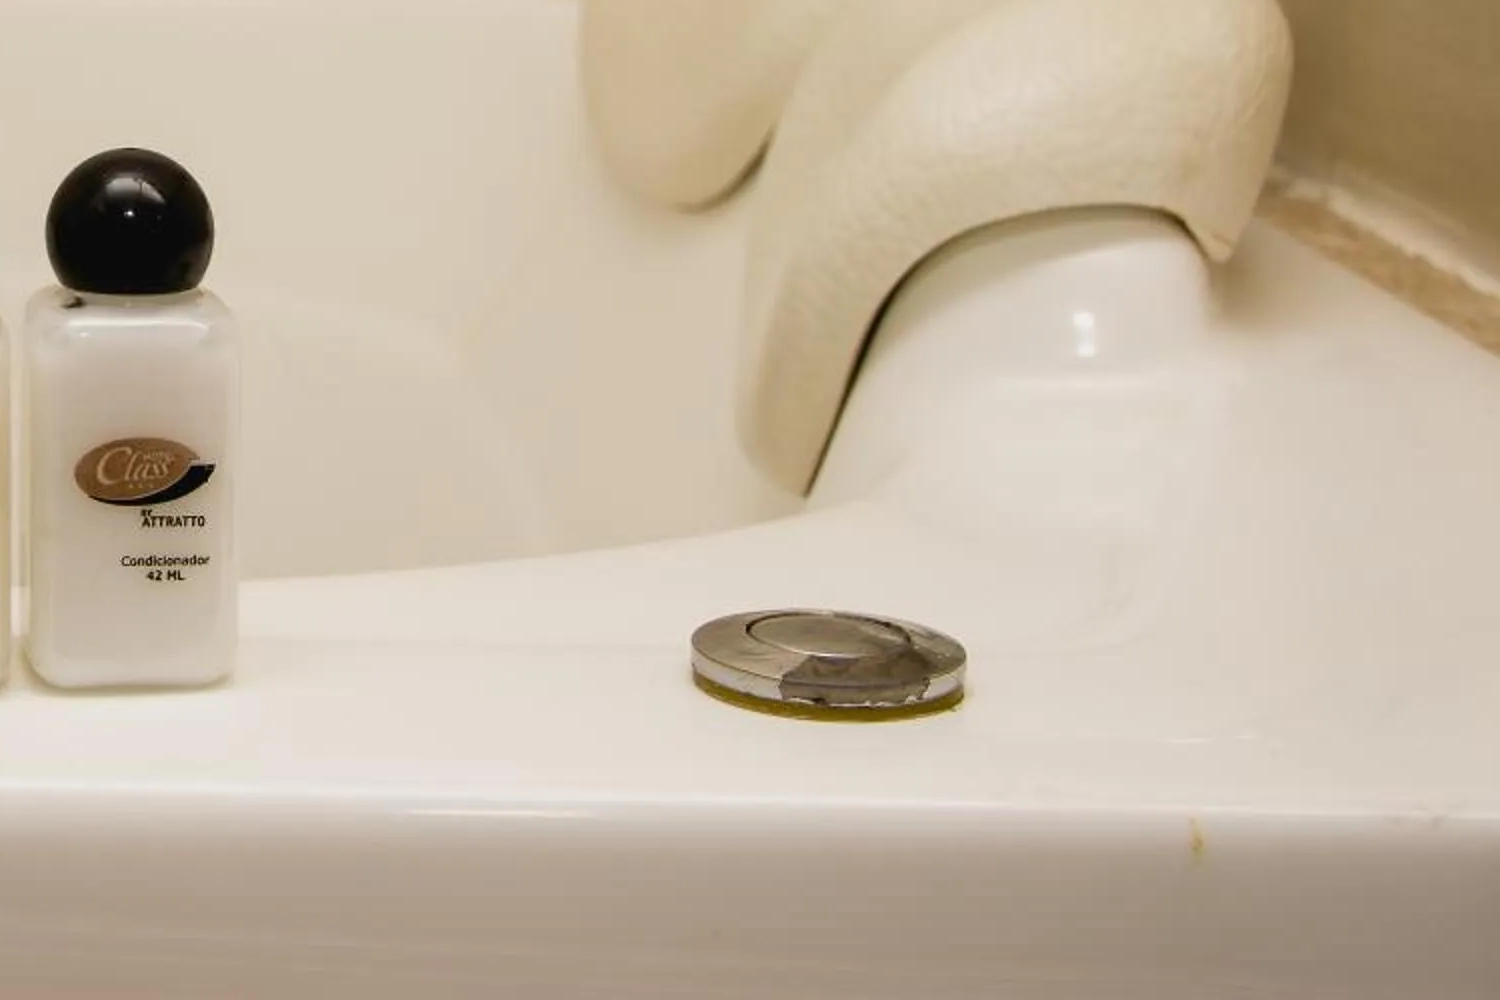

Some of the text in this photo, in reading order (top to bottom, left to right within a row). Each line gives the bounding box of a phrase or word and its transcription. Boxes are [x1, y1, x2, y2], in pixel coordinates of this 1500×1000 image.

[96, 446, 169, 485] Class
[141, 515, 205, 528] ATTRATTO
[121, 554, 210, 567] Condicionador
[146, 570, 163, 581] 42
